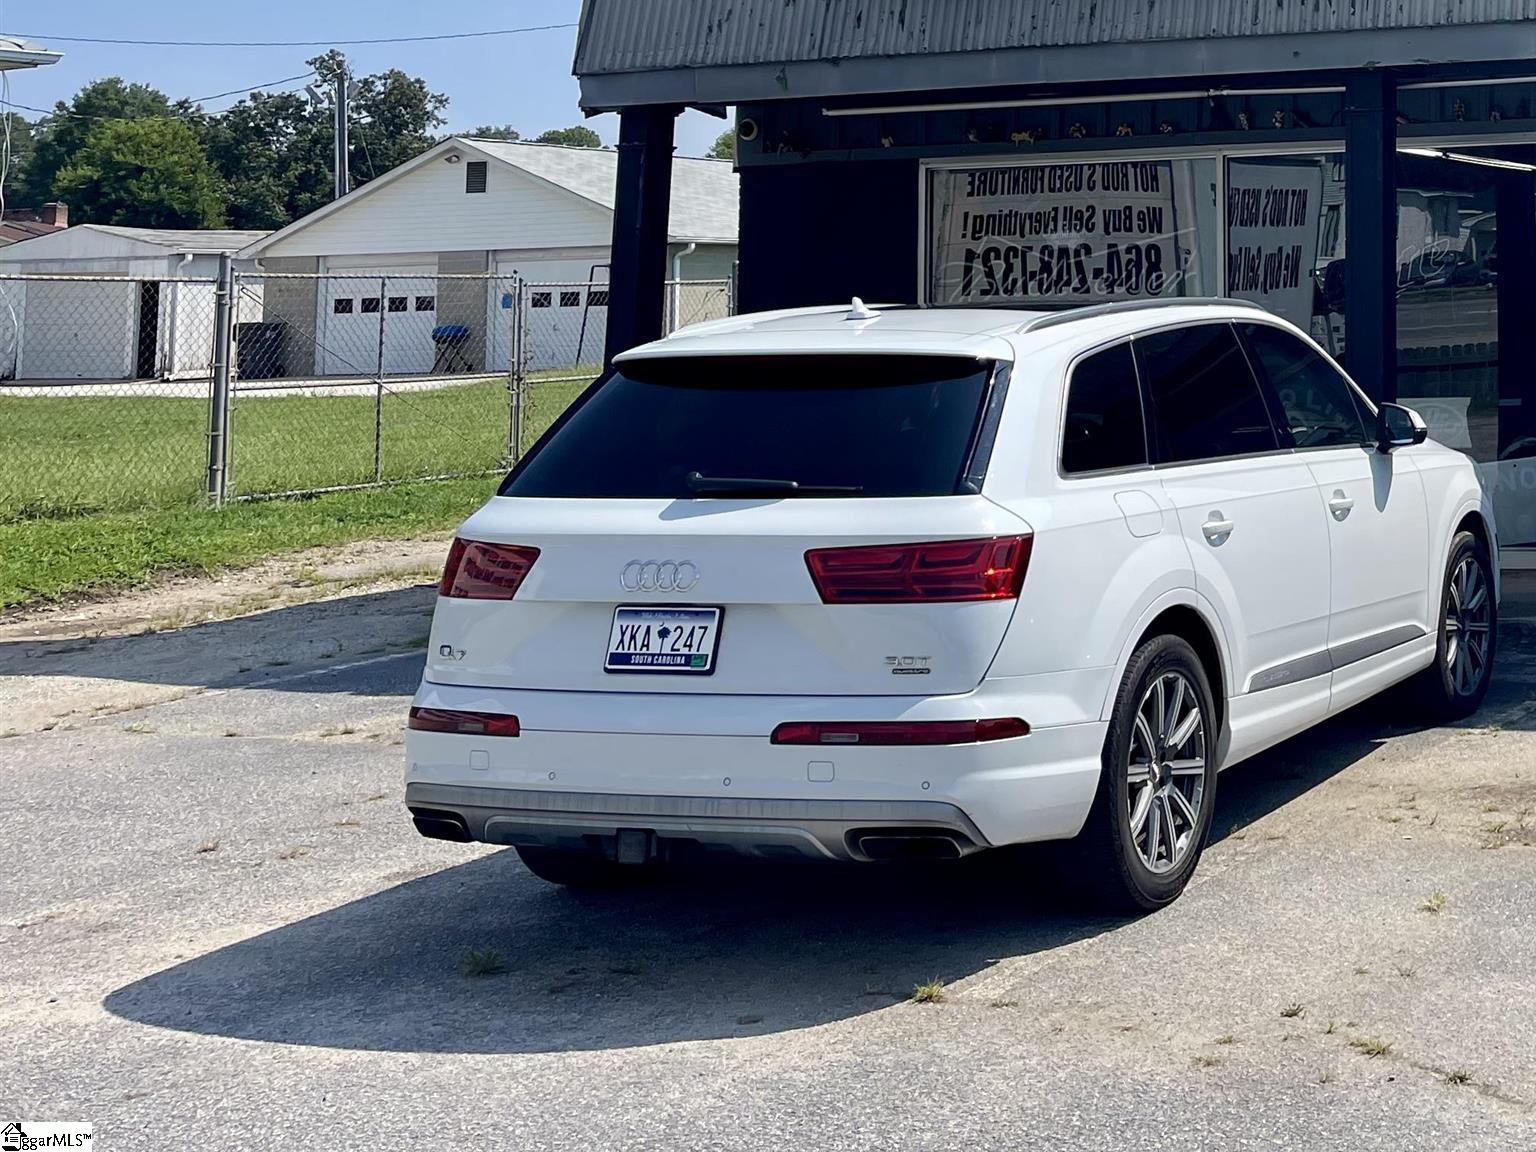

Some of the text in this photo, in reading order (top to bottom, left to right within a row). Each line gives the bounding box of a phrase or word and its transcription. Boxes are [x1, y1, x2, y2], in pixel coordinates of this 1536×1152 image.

[615, 624, 709, 653] XKA 247
[630, 654, 686, 665] SOUTH CAROLINA
